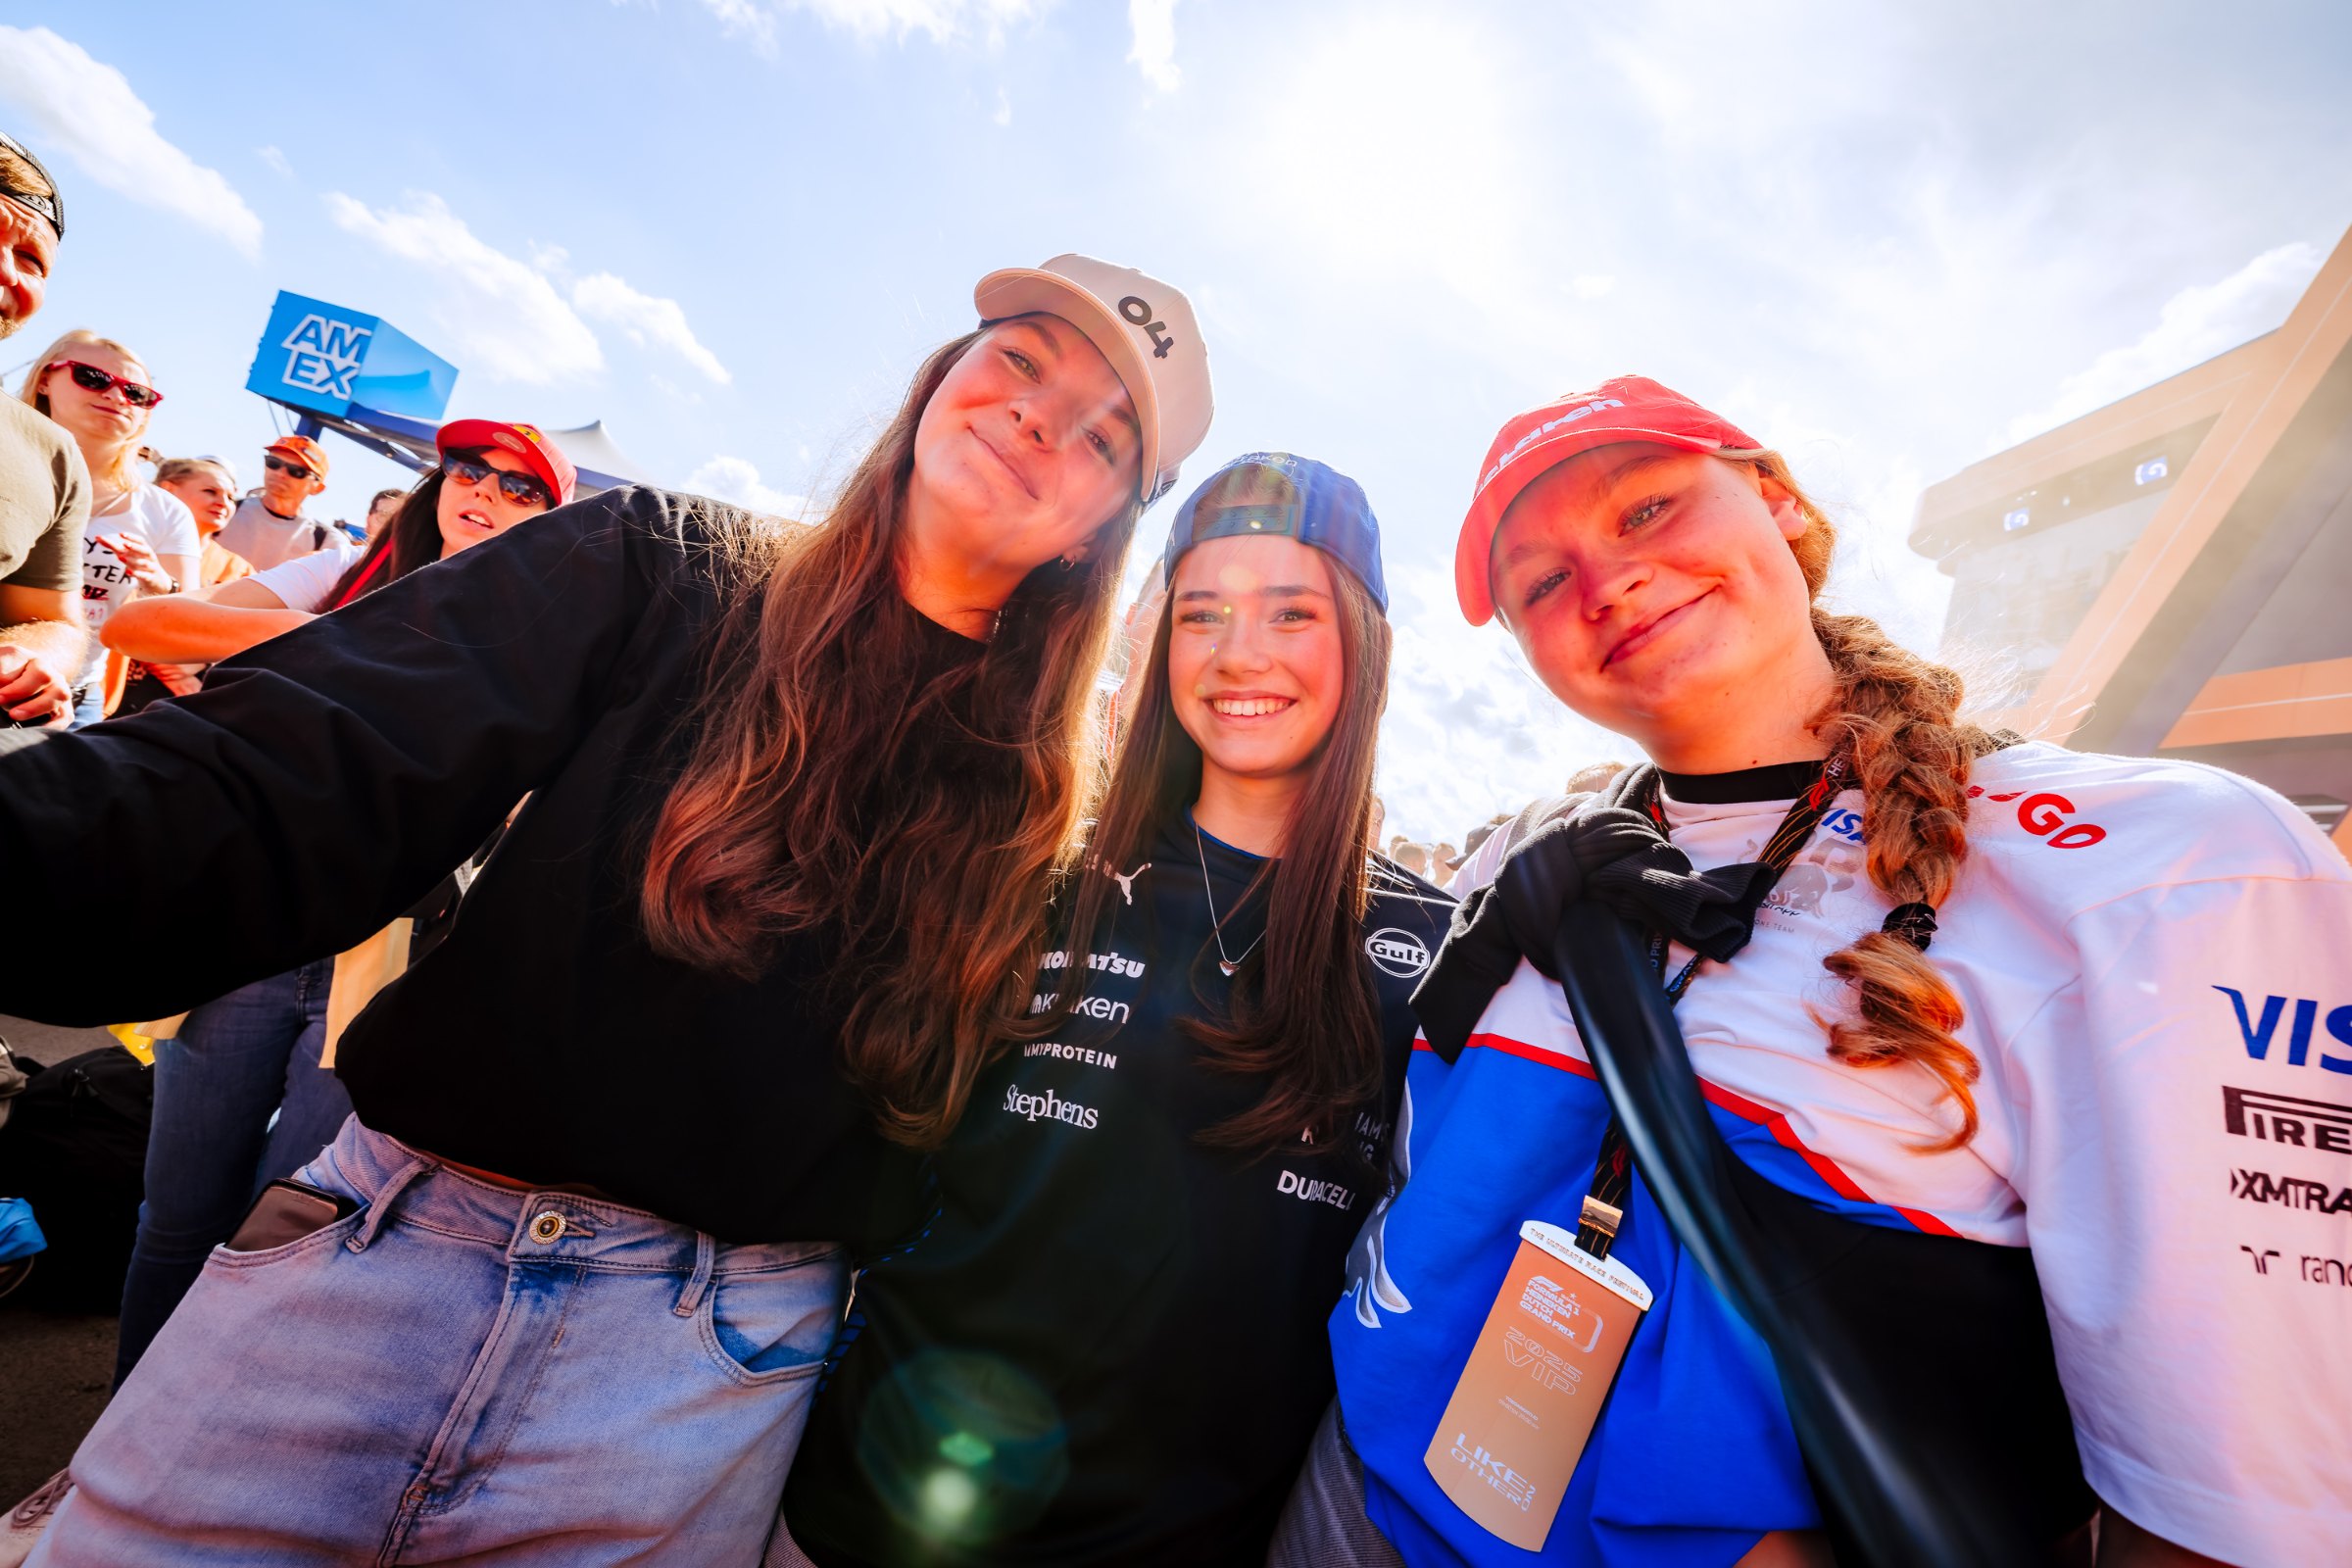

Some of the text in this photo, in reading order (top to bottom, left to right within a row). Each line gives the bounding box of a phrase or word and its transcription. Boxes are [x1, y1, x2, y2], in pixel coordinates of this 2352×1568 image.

[281, 314, 372, 368] AM
[1118, 296, 1174, 359] 04
[282, 349, 361, 401] EX
[1966, 786, 2107, 849] GO
[1370, 941, 1425, 963] Gulf
[2211, 985, 2352, 1076] VIS
[1004, 1084, 1099, 1129] Stephens
[2222, 1085, 2352, 1155] PIRE
[2231, 1168, 2352, 1215] XMTRA
[1519, 1300, 1576, 1339] GRAND PRIX
[1522, 1293, 1553, 1317] DUTCH
[1525, 1286, 1571, 1319] HEINEKEN
[1528, 1279, 1573, 1312] FORMULA
[1503, 1339, 1576, 1396] VIP
[1505, 1326, 1584, 1383] 2025
[1451, 1447, 1522, 1506] OTHER
[1456, 1433, 1528, 1494] LIKE
